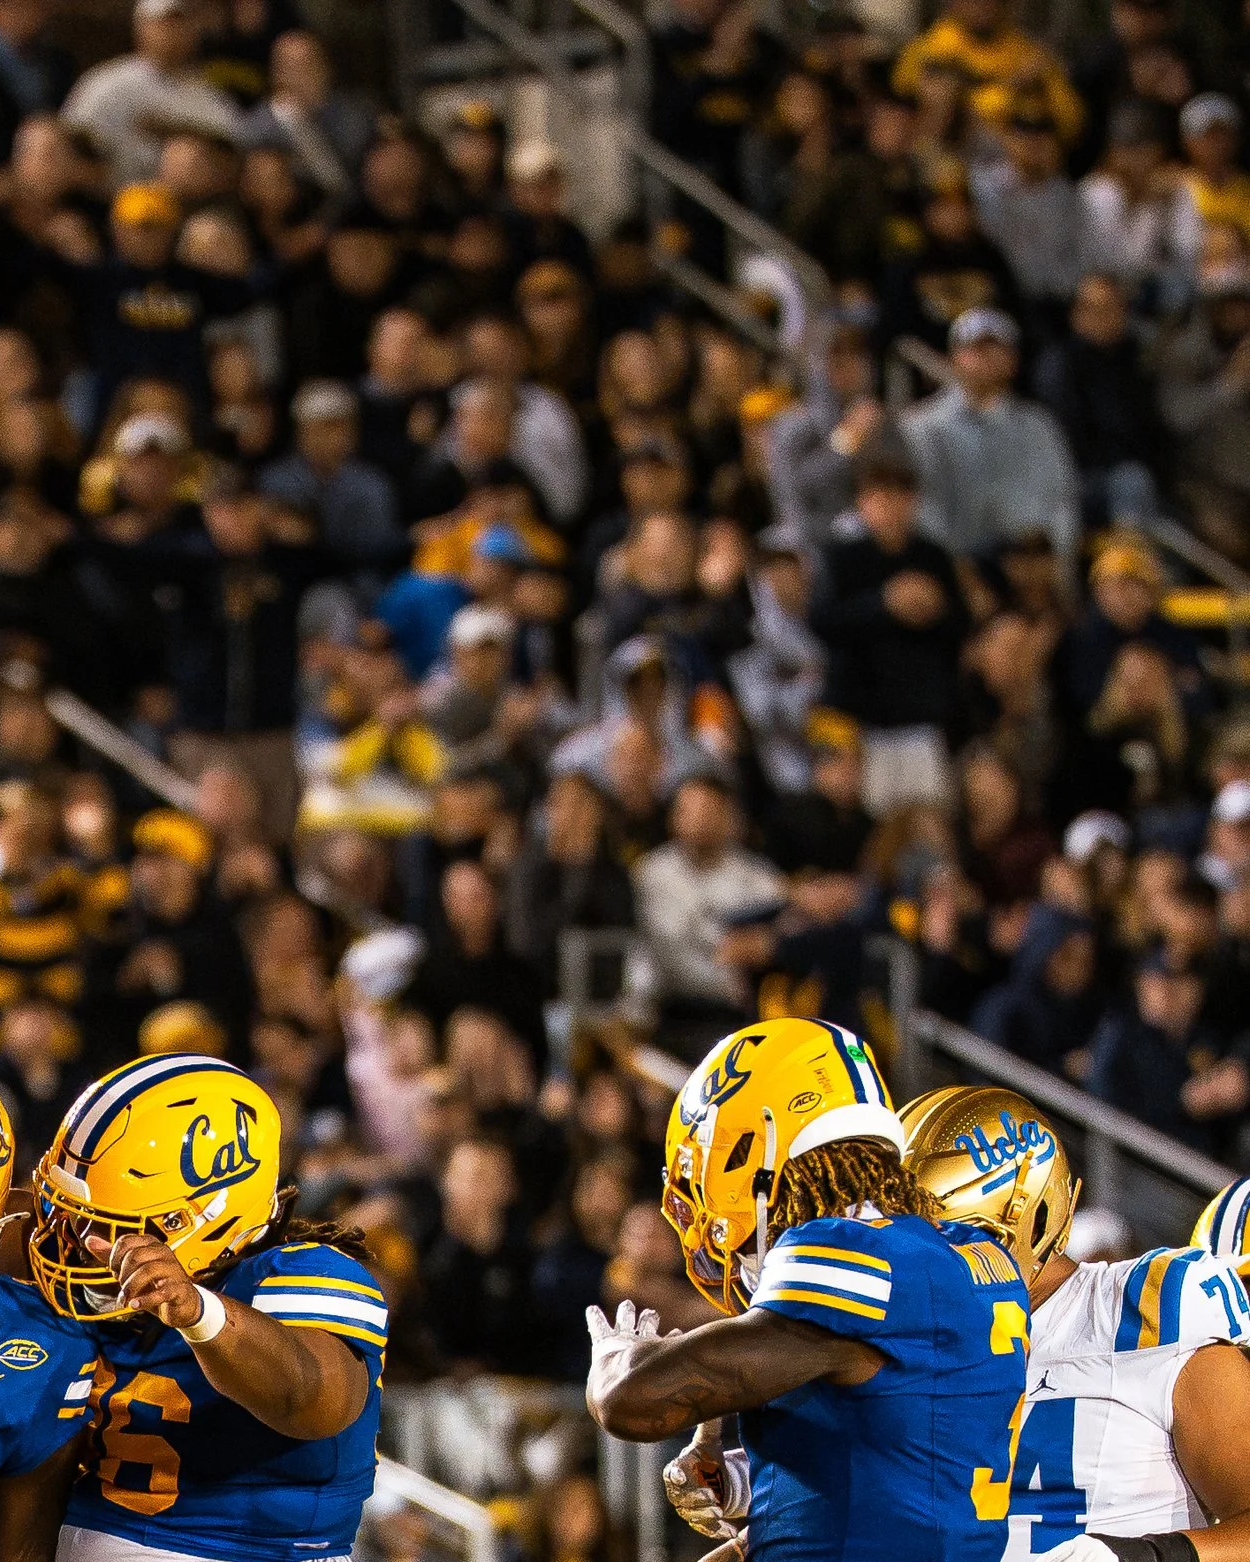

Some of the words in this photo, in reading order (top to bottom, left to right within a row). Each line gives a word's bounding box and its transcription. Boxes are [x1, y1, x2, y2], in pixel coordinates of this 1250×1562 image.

[794, 1095, 816, 1109] ACC
[180, 1103, 261, 1201] Cal
[2, 1345, 41, 1359] ACC
[86, 1355, 192, 1516] 6
[970, 1301, 1031, 1520] 3
